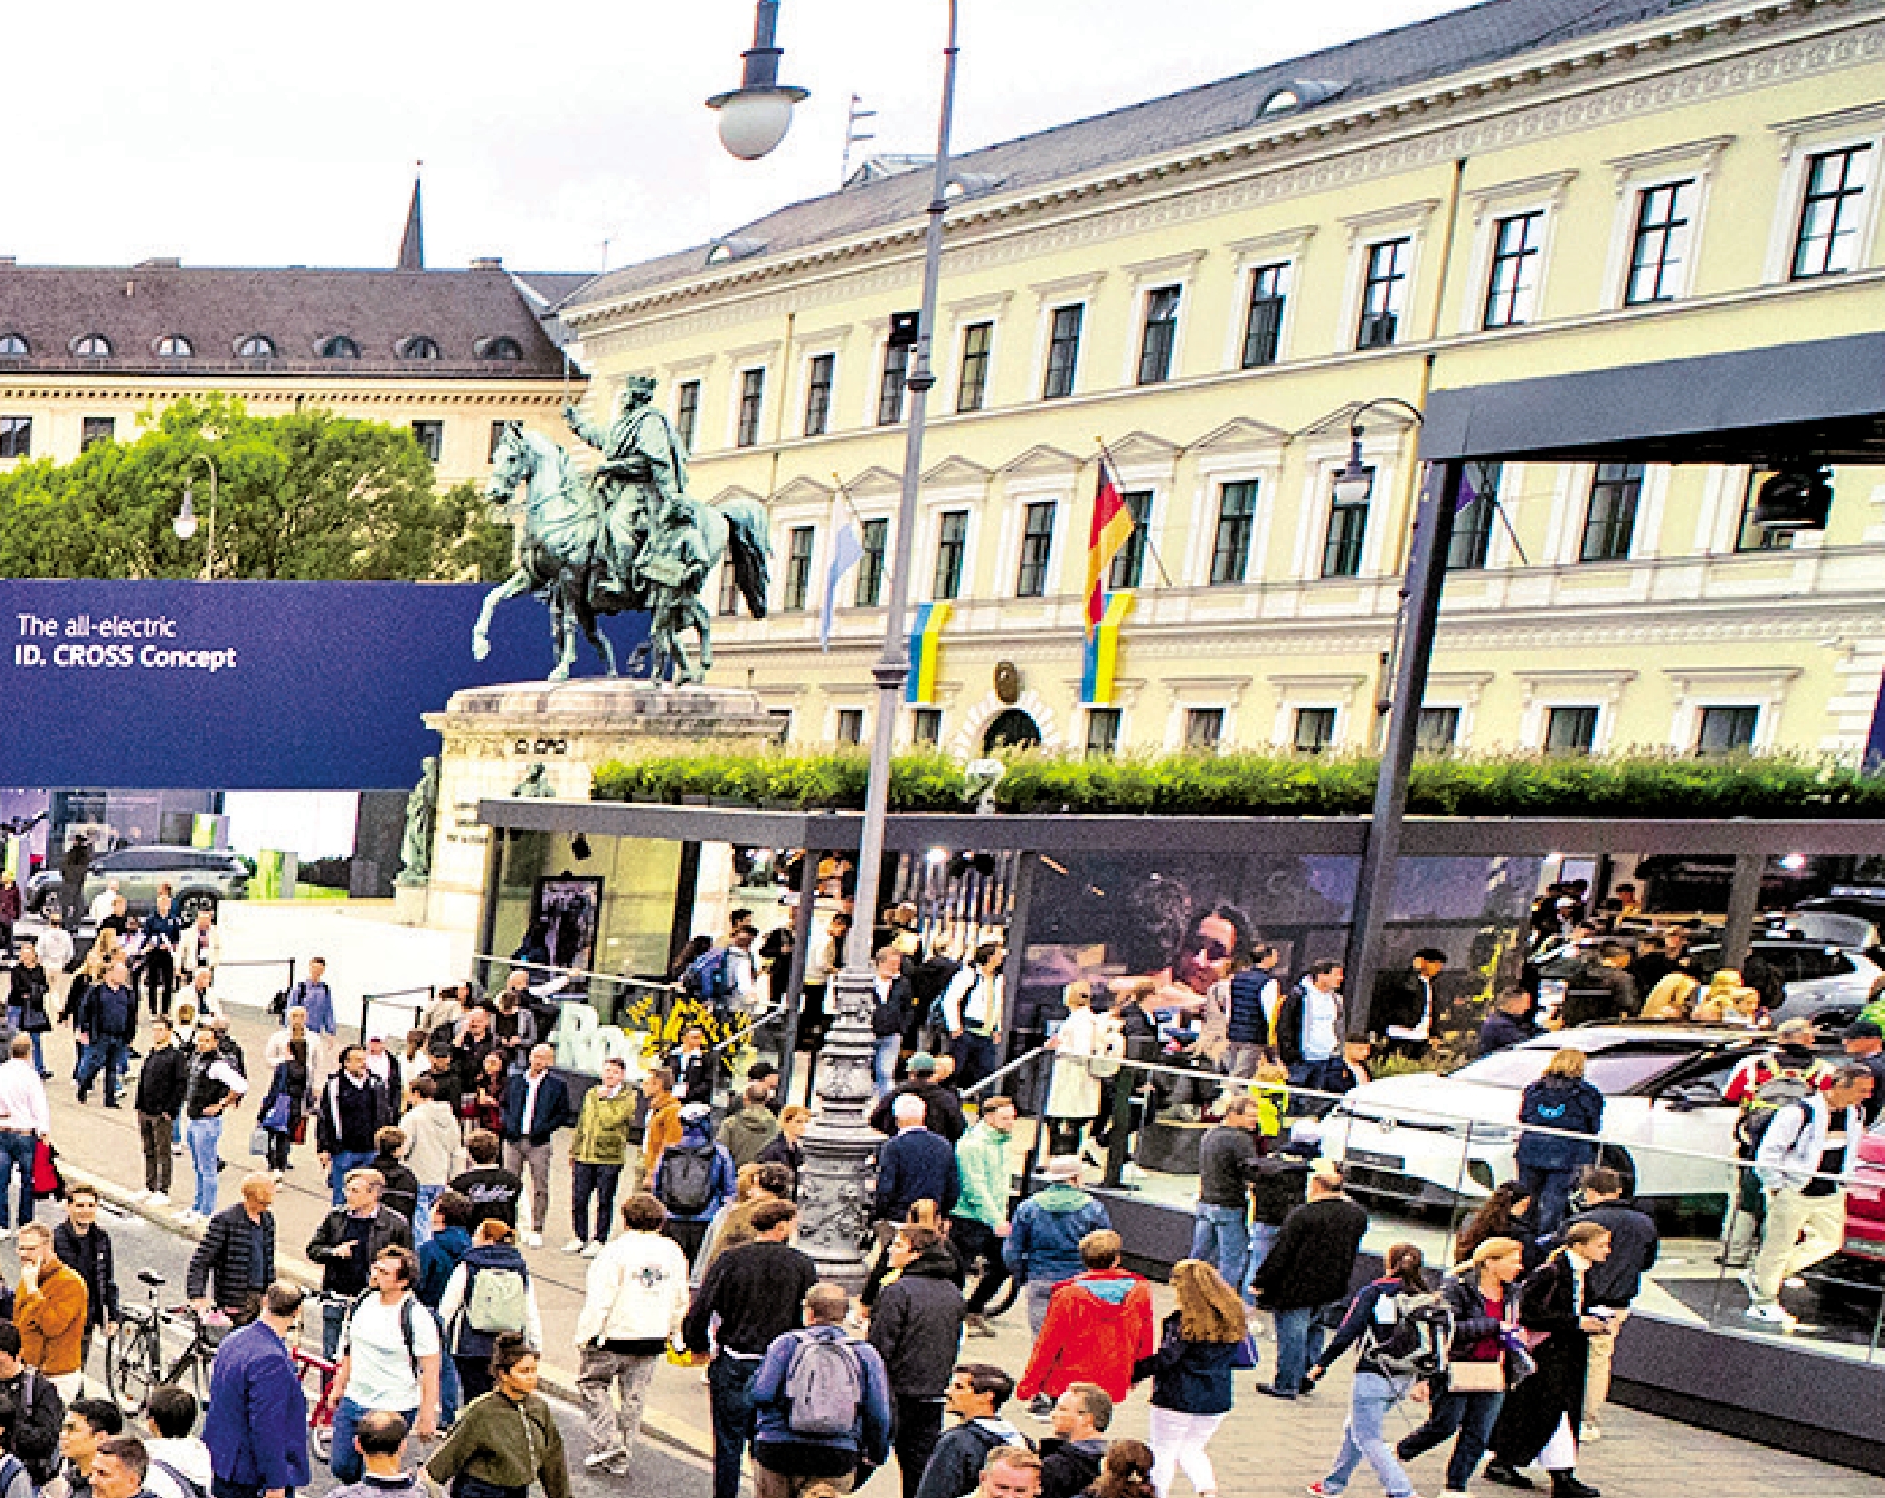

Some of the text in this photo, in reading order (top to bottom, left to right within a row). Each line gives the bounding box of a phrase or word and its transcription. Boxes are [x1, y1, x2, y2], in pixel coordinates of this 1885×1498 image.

[17, 613, 177, 638] The all-electric
[15, 644, 237, 672] ID. CROSS Concept
